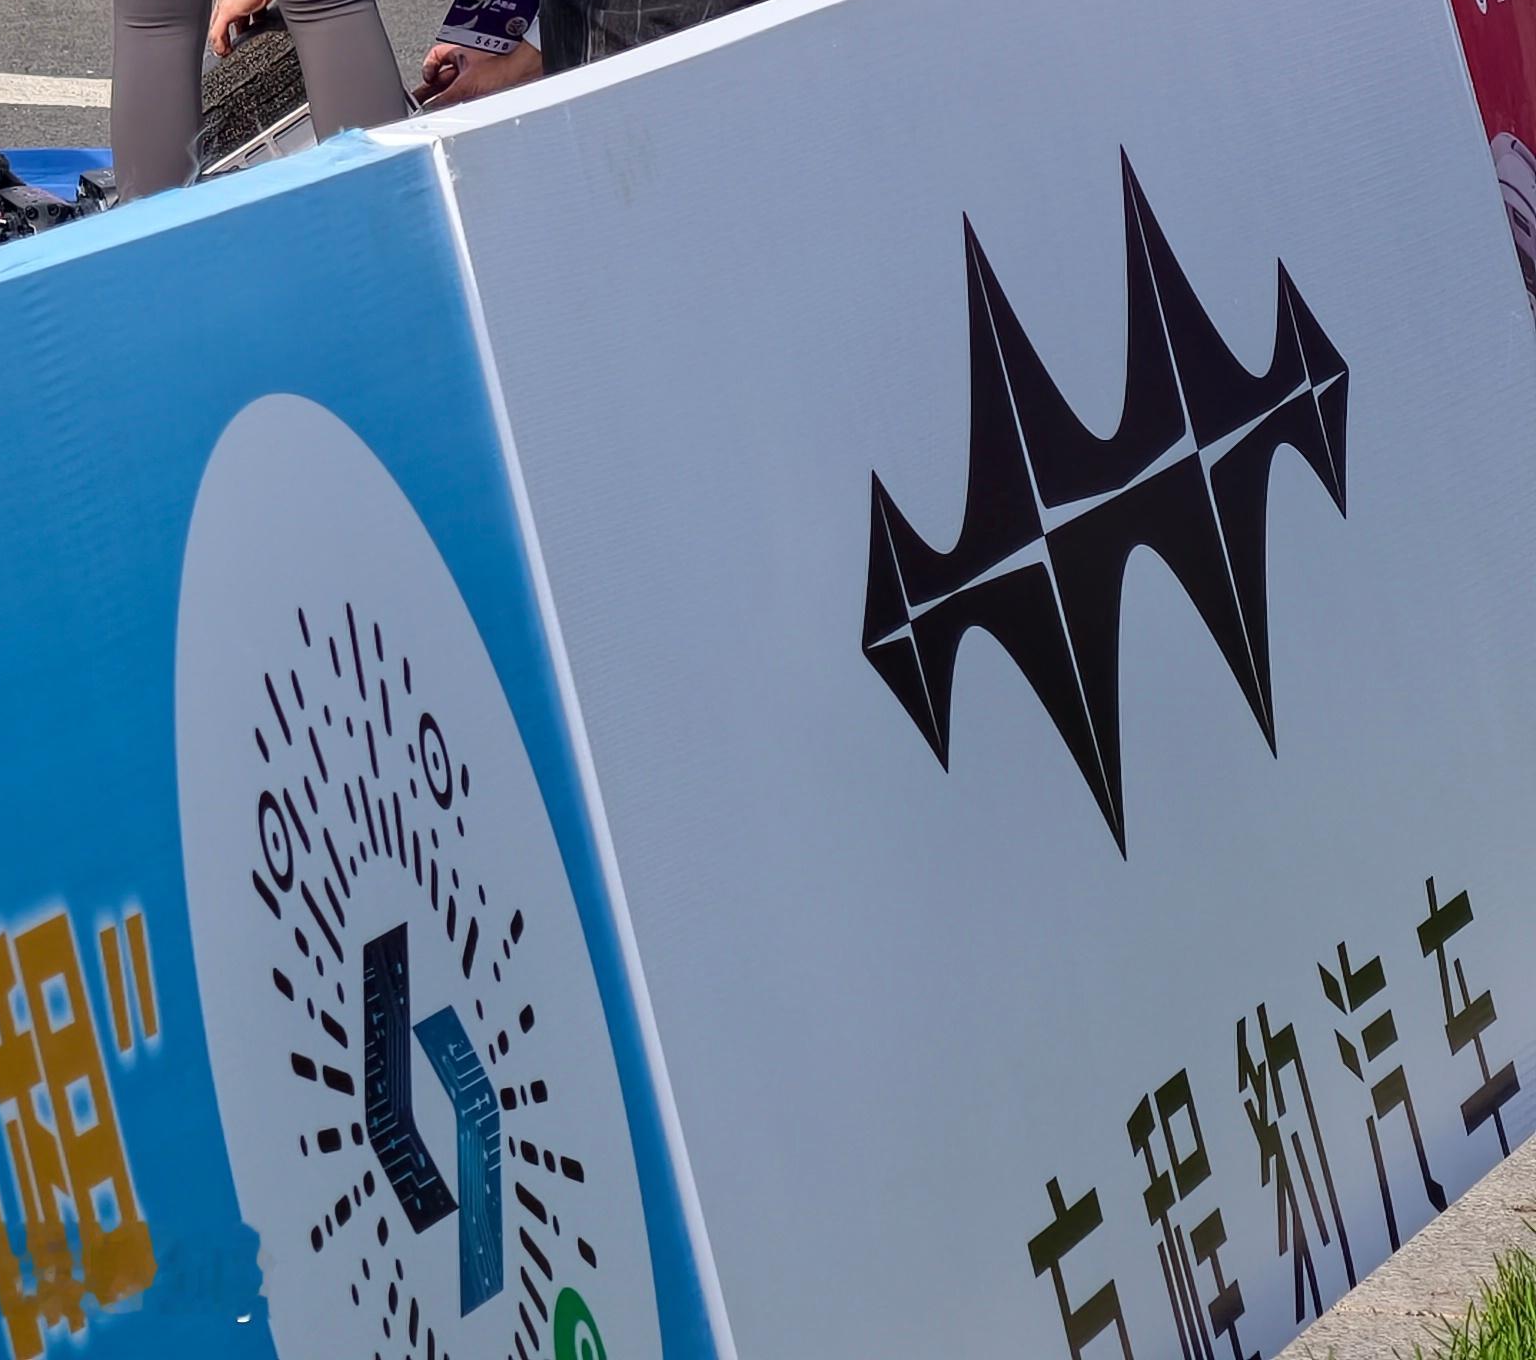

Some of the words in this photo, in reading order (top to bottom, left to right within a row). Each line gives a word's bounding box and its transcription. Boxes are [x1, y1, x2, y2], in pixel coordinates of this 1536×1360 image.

[1026, 876, 1522, 1360] 方程豹汽车
